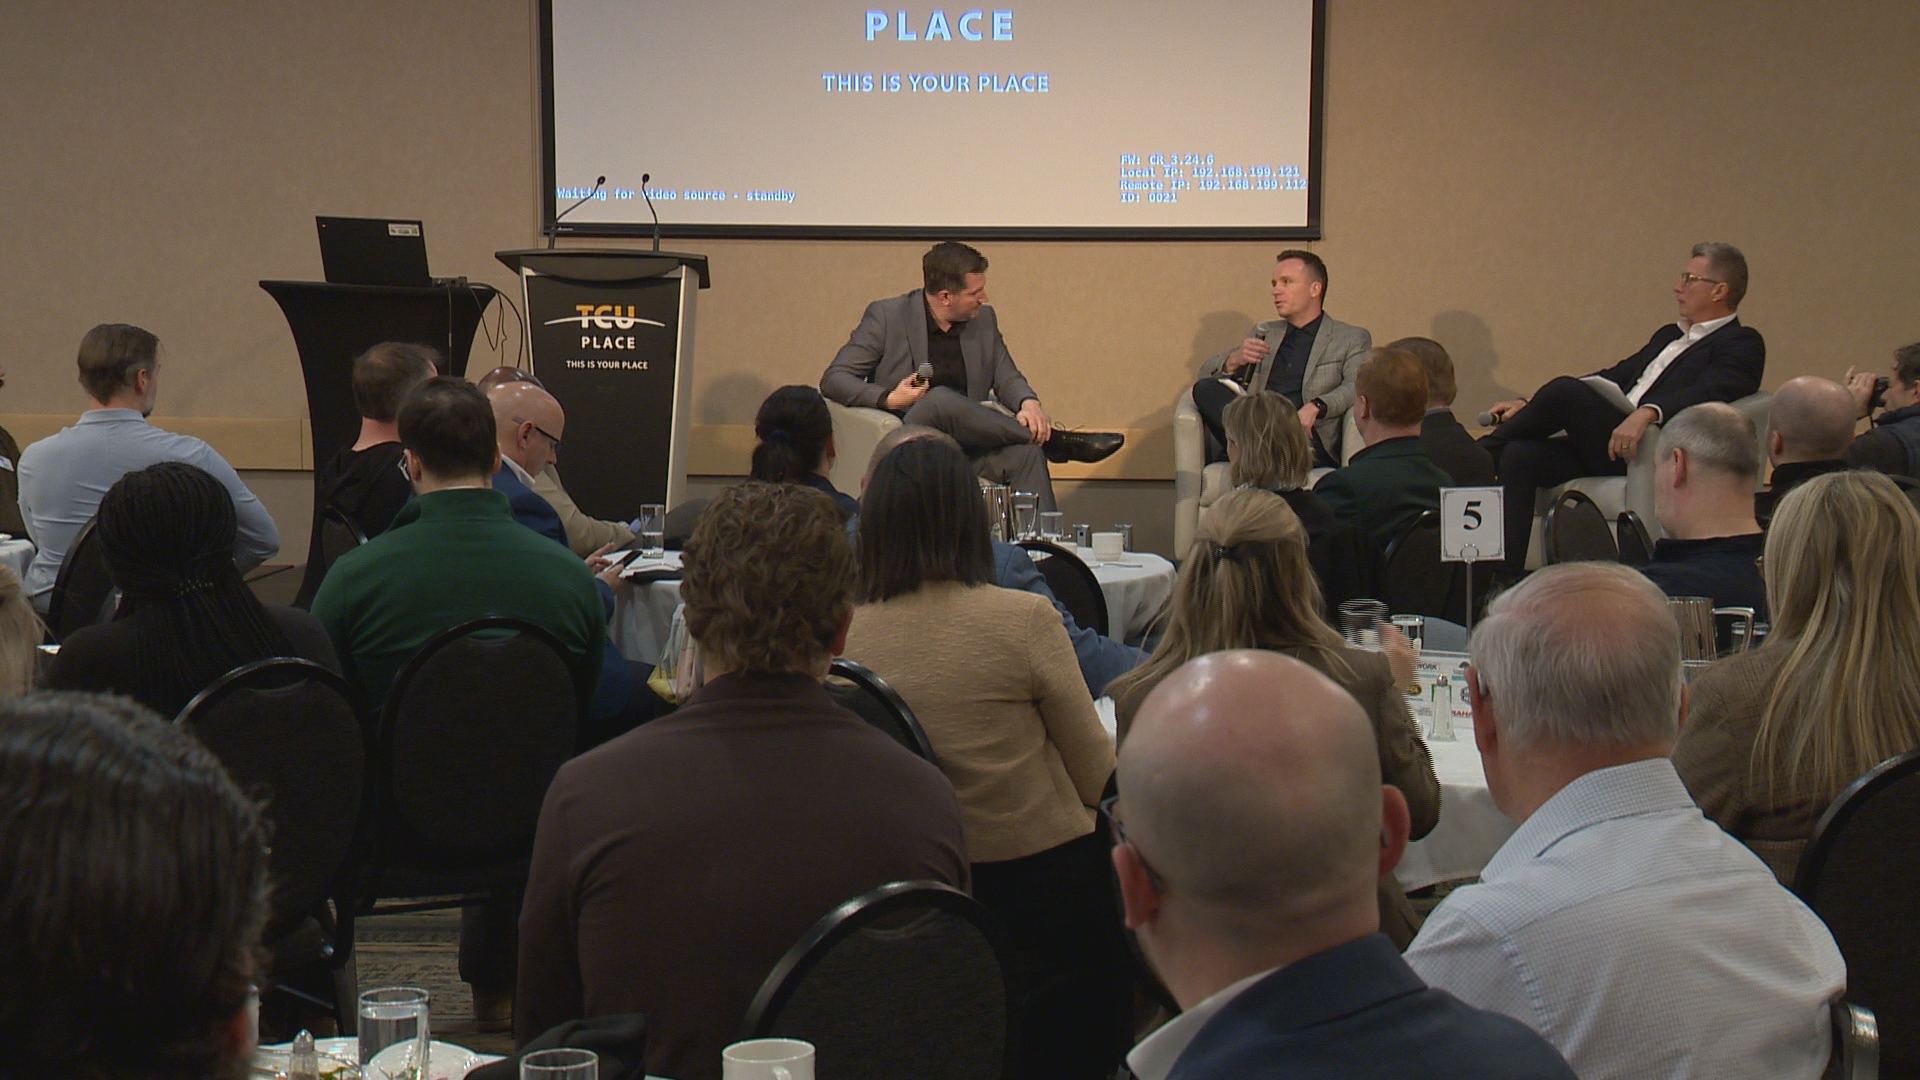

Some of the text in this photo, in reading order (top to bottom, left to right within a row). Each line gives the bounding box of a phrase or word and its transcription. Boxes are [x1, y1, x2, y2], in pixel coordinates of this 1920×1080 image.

[865, 9, 1013, 41] PLACE
[822, 72, 1049, 92] THIS IS YOUR PLACE
[1120, 153, 1214, 167] FW: CR_3.24.6
[1120, 166, 1300, 178] Local IP: 192.168.199.121
[1120, 179, 1307, 190] Remote IP: 192.168.199.112
[556, 187, 607, 201] Waiting
[614, 187, 635, 200] for
[642, 188, 677, 201] video
[683, 190, 726, 201] source
[746, 190, 795, 203] standby
[1120, 192, 1178, 203] ID: 0021
[575, 304, 636, 329] TCU
[581, 336, 636, 349] PLACE
[566, 360, 648, 370] THIS IS YOUR PLACE
[1463, 500, 1482, 530] 5
